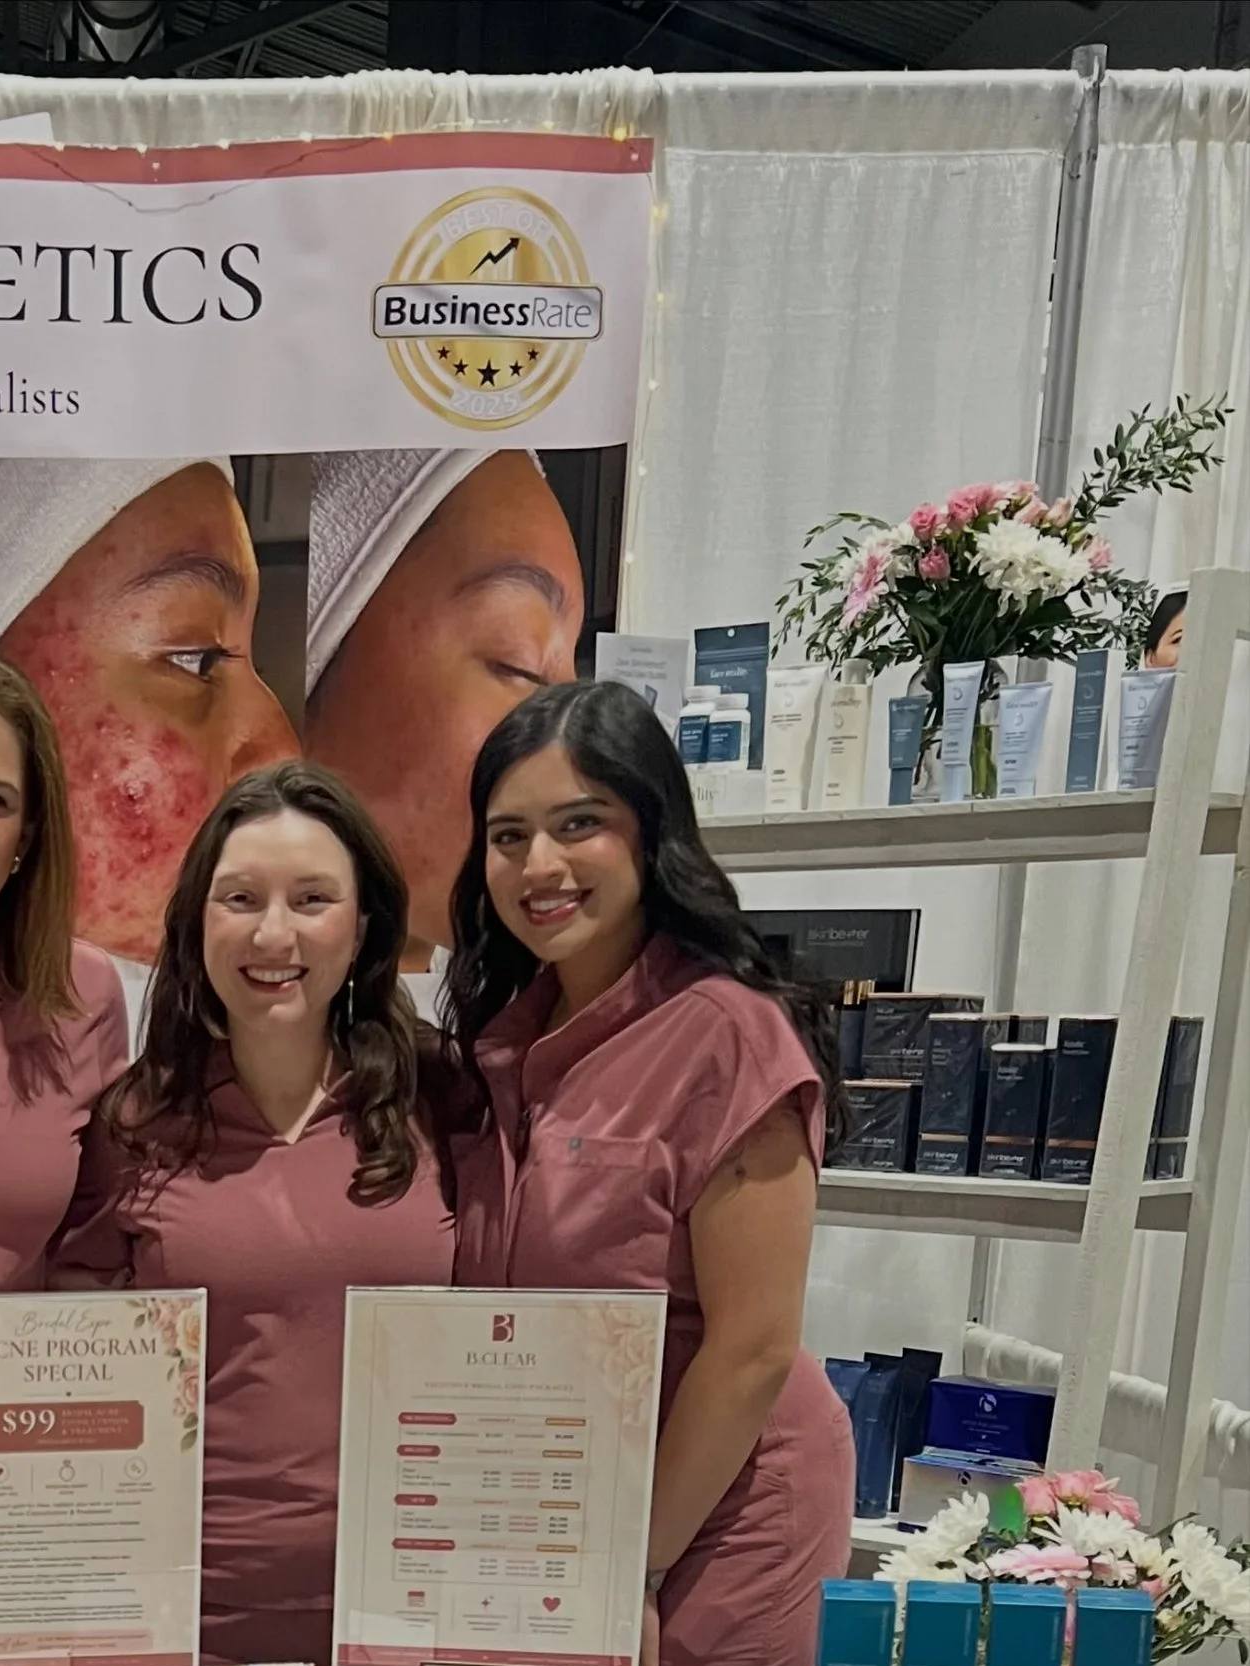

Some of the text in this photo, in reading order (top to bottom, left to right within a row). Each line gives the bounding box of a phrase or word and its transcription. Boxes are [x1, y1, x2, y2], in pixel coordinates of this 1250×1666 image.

[443, 203, 550, 236] BEST OF
[384, 295, 592, 328] BusinessRate
[451, 391, 520, 416] 2025
[46, 1337, 158, 1358] PROGRAM
[22, 1363, 114, 1383] SPECIAL
[2, 1408, 56, 1436] $99
